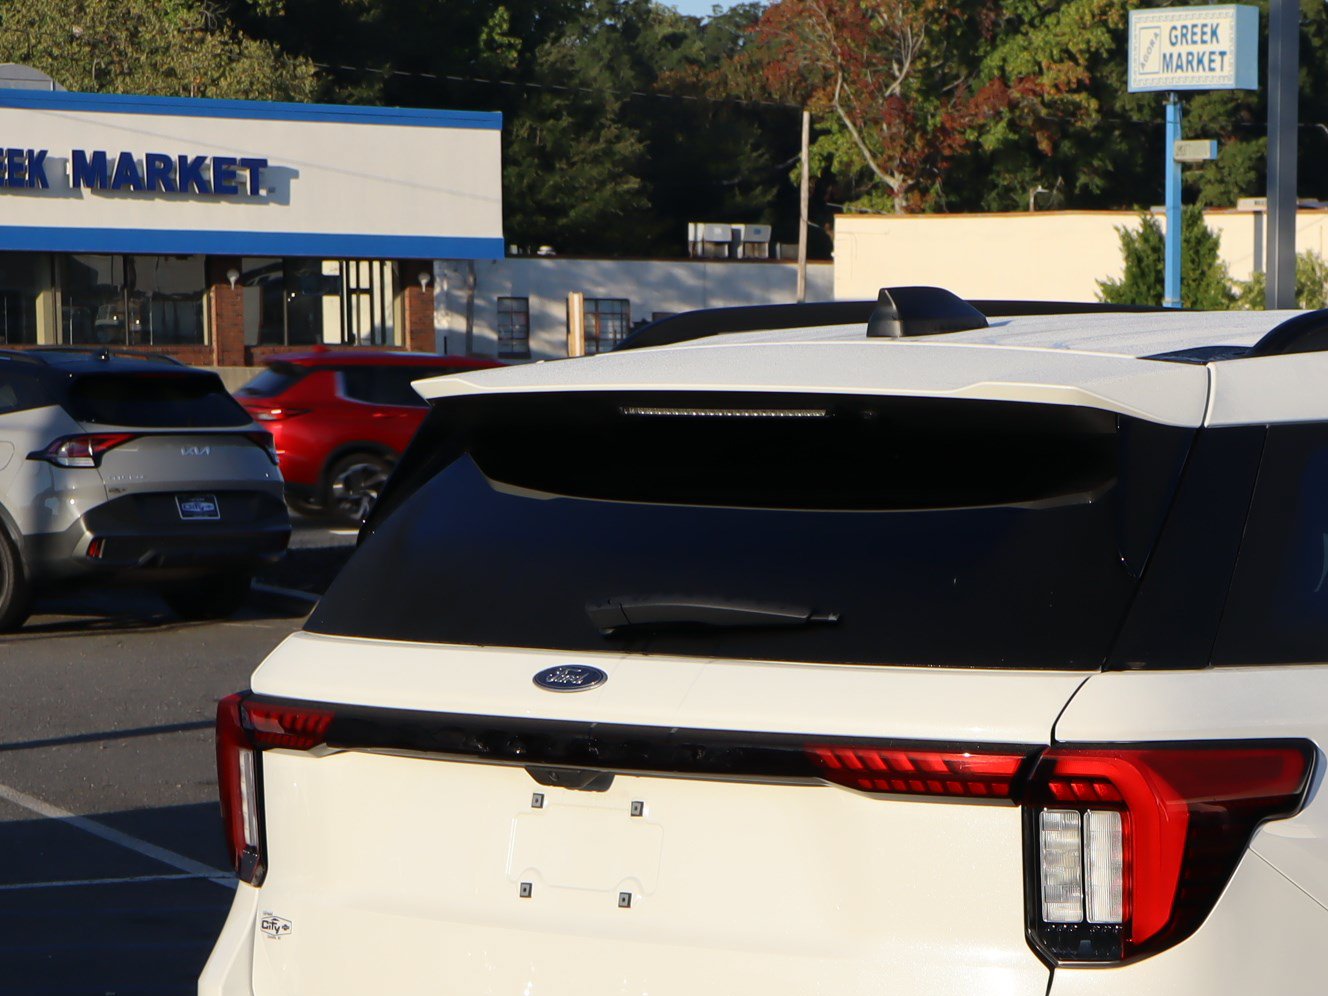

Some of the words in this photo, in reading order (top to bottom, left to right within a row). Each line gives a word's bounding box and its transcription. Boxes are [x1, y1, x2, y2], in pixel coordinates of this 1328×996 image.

[1169, 23, 1220, 46] GREEK
[1140, 31, 1160, 70] AGORA
[1162, 51, 1228, 73] MARKET
[71, 149, 268, 196] MARKET
[545, 667, 590, 684] Ford
